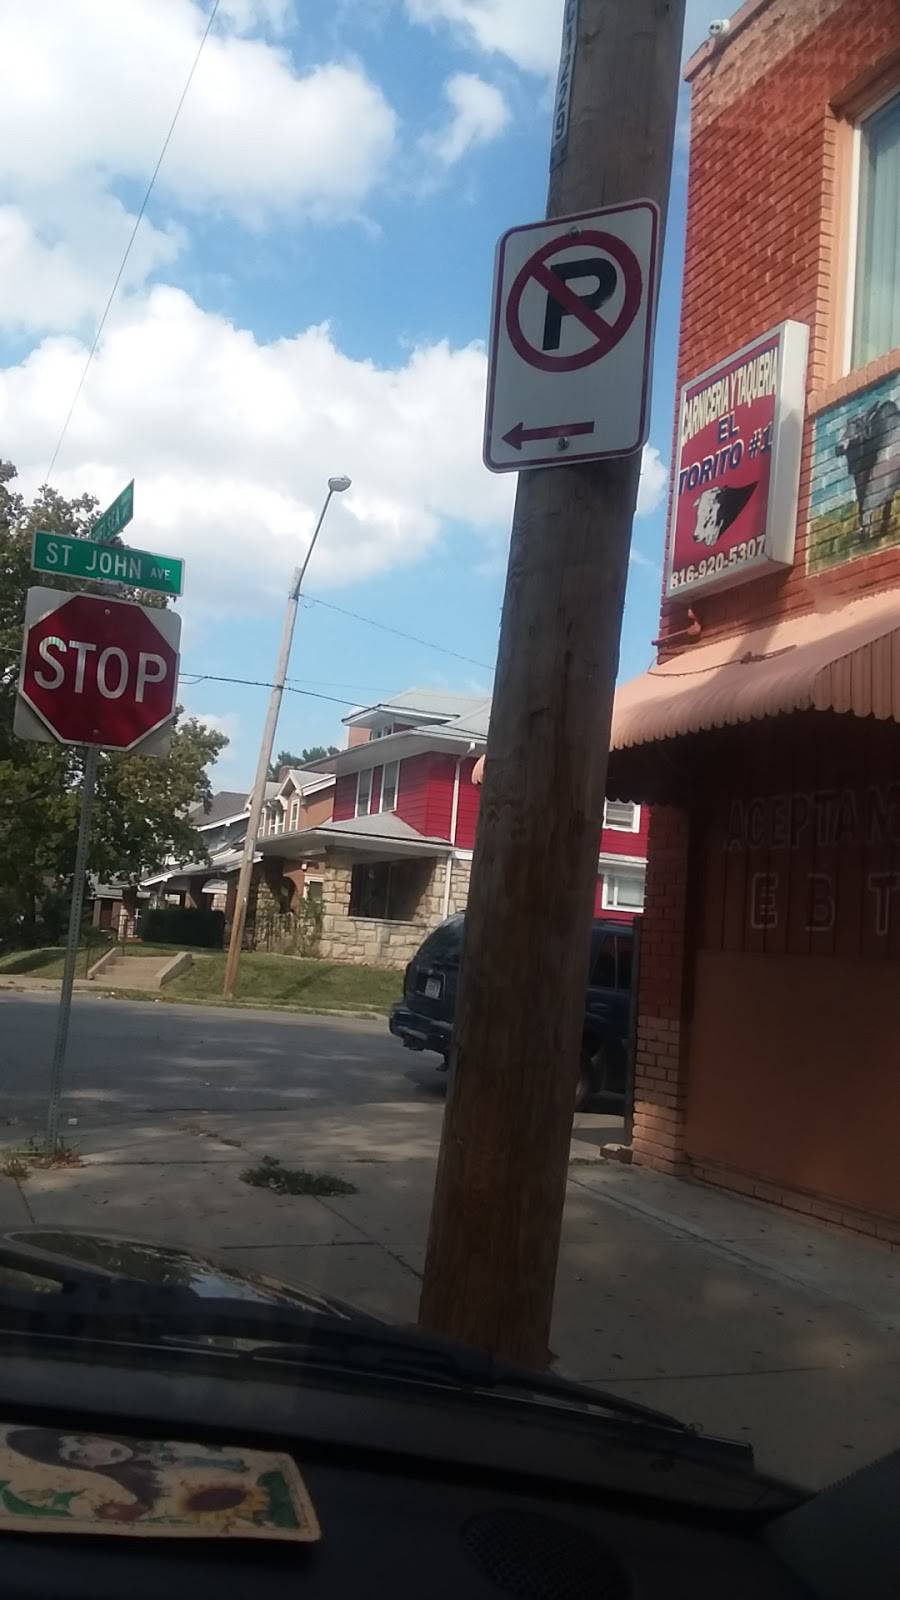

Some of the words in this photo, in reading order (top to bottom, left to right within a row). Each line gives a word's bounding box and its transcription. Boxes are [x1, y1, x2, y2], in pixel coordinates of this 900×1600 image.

[681, 375, 730, 447] CARNICERIA
[736, 346, 779, 408] TAQUERIA
[718, 411, 740, 443] EL
[679, 438, 744, 496] TORITO
[748, 421, 774, 459] #1
[46, 542, 73, 566] ST
[86, 551, 143, 580] JOHN
[150, 568, 172, 582] AVE
[670, 534, 767, 590] 816-920-5307
[34, 635, 168, 704] STOP
